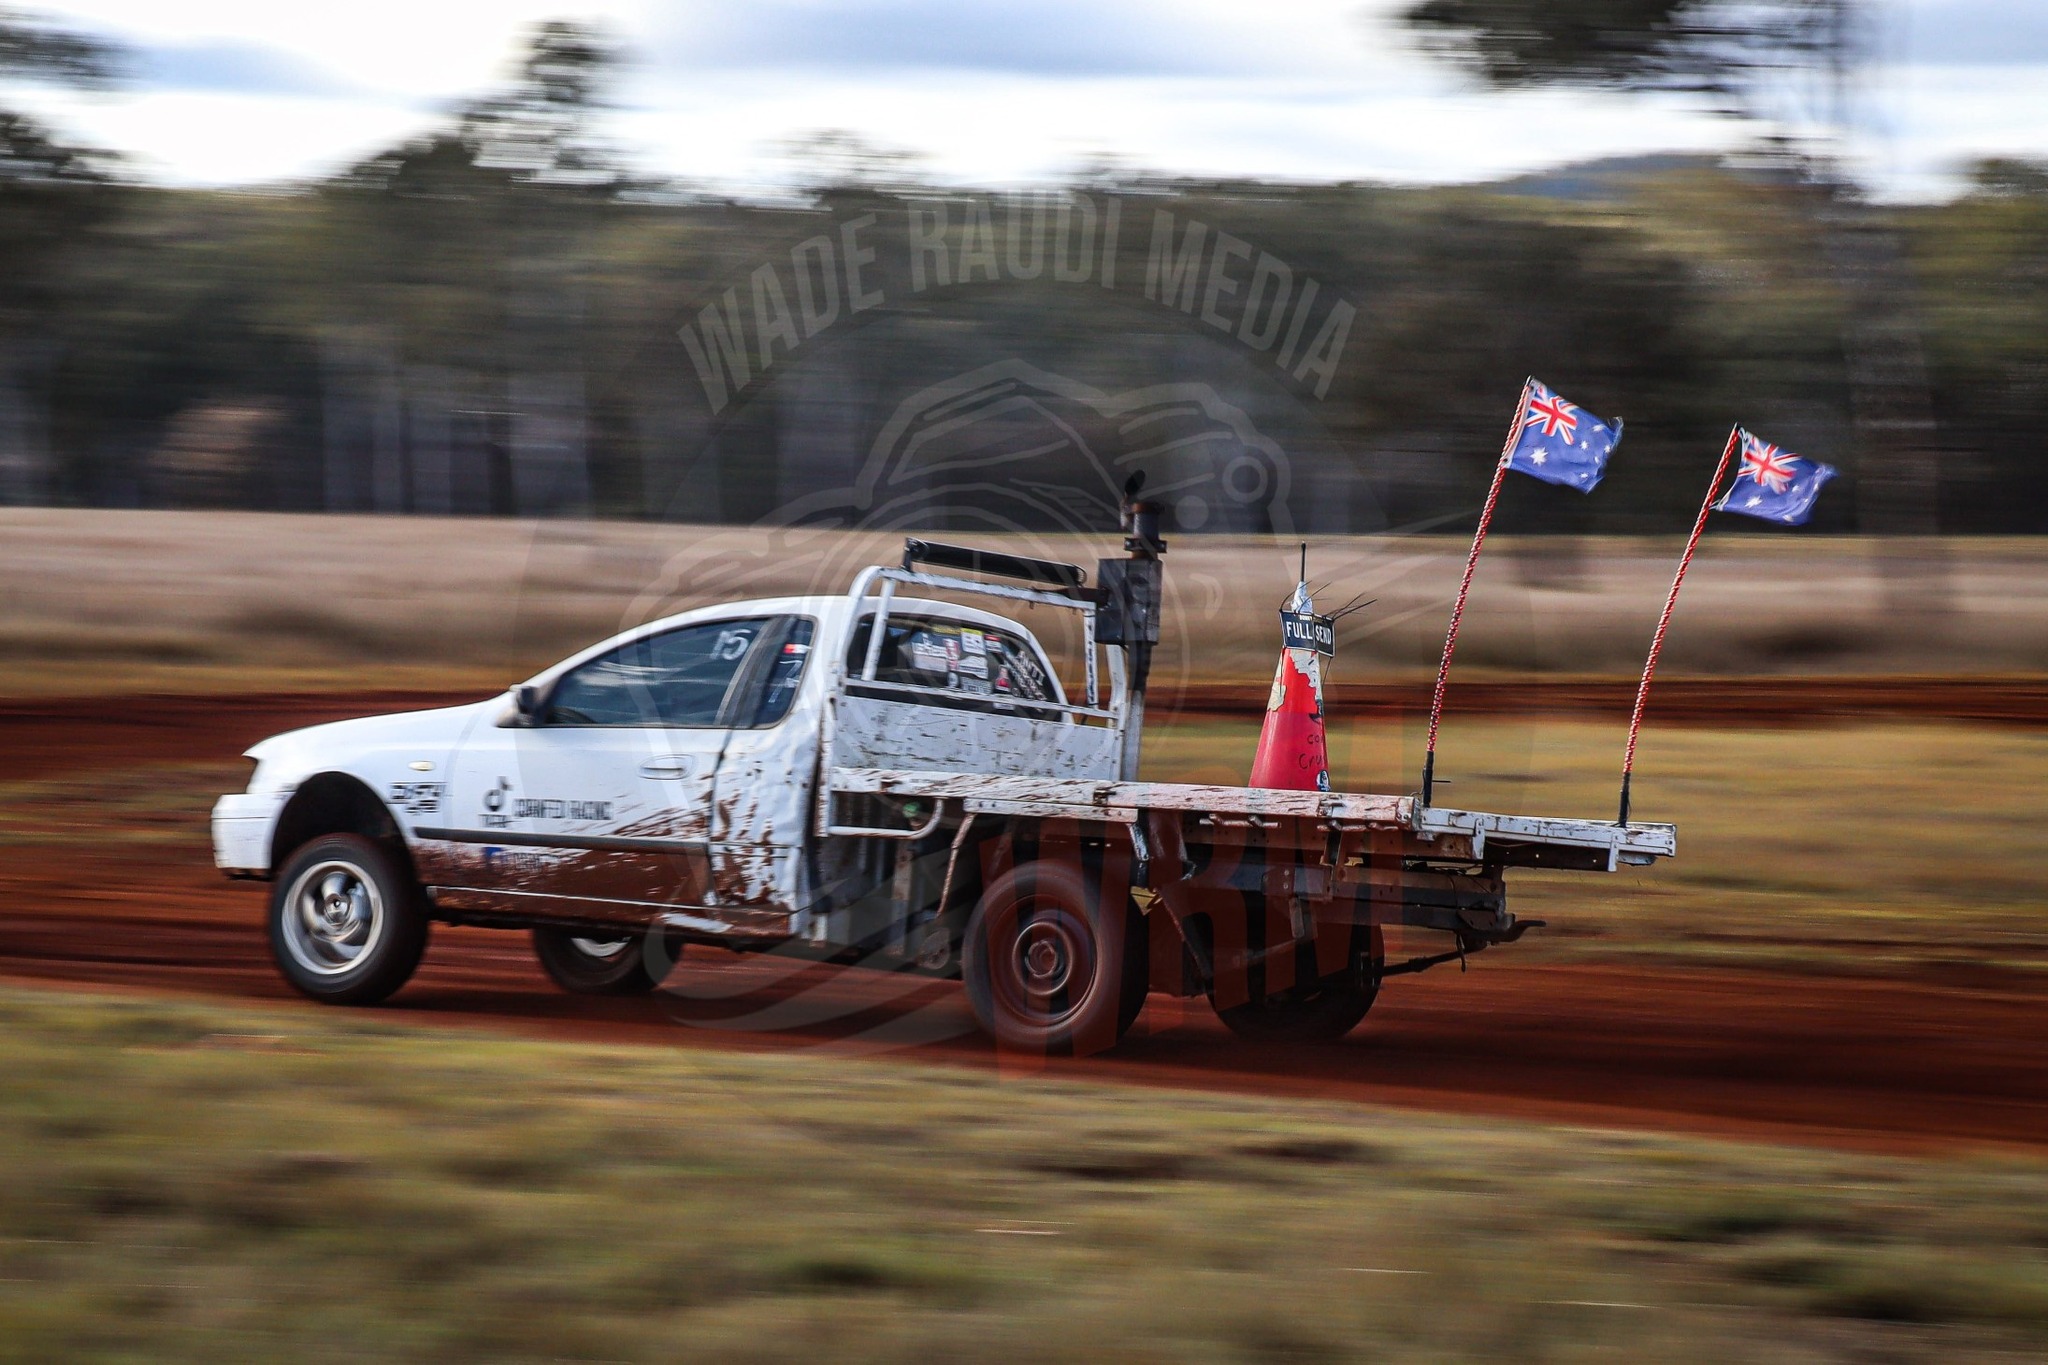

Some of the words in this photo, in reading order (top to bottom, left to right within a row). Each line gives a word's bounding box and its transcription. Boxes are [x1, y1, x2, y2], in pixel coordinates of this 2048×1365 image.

[711, 628, 751, 660] 15
[1285, 621, 1313, 640] FULL
[1315, 624, 1332, 645] SEND
